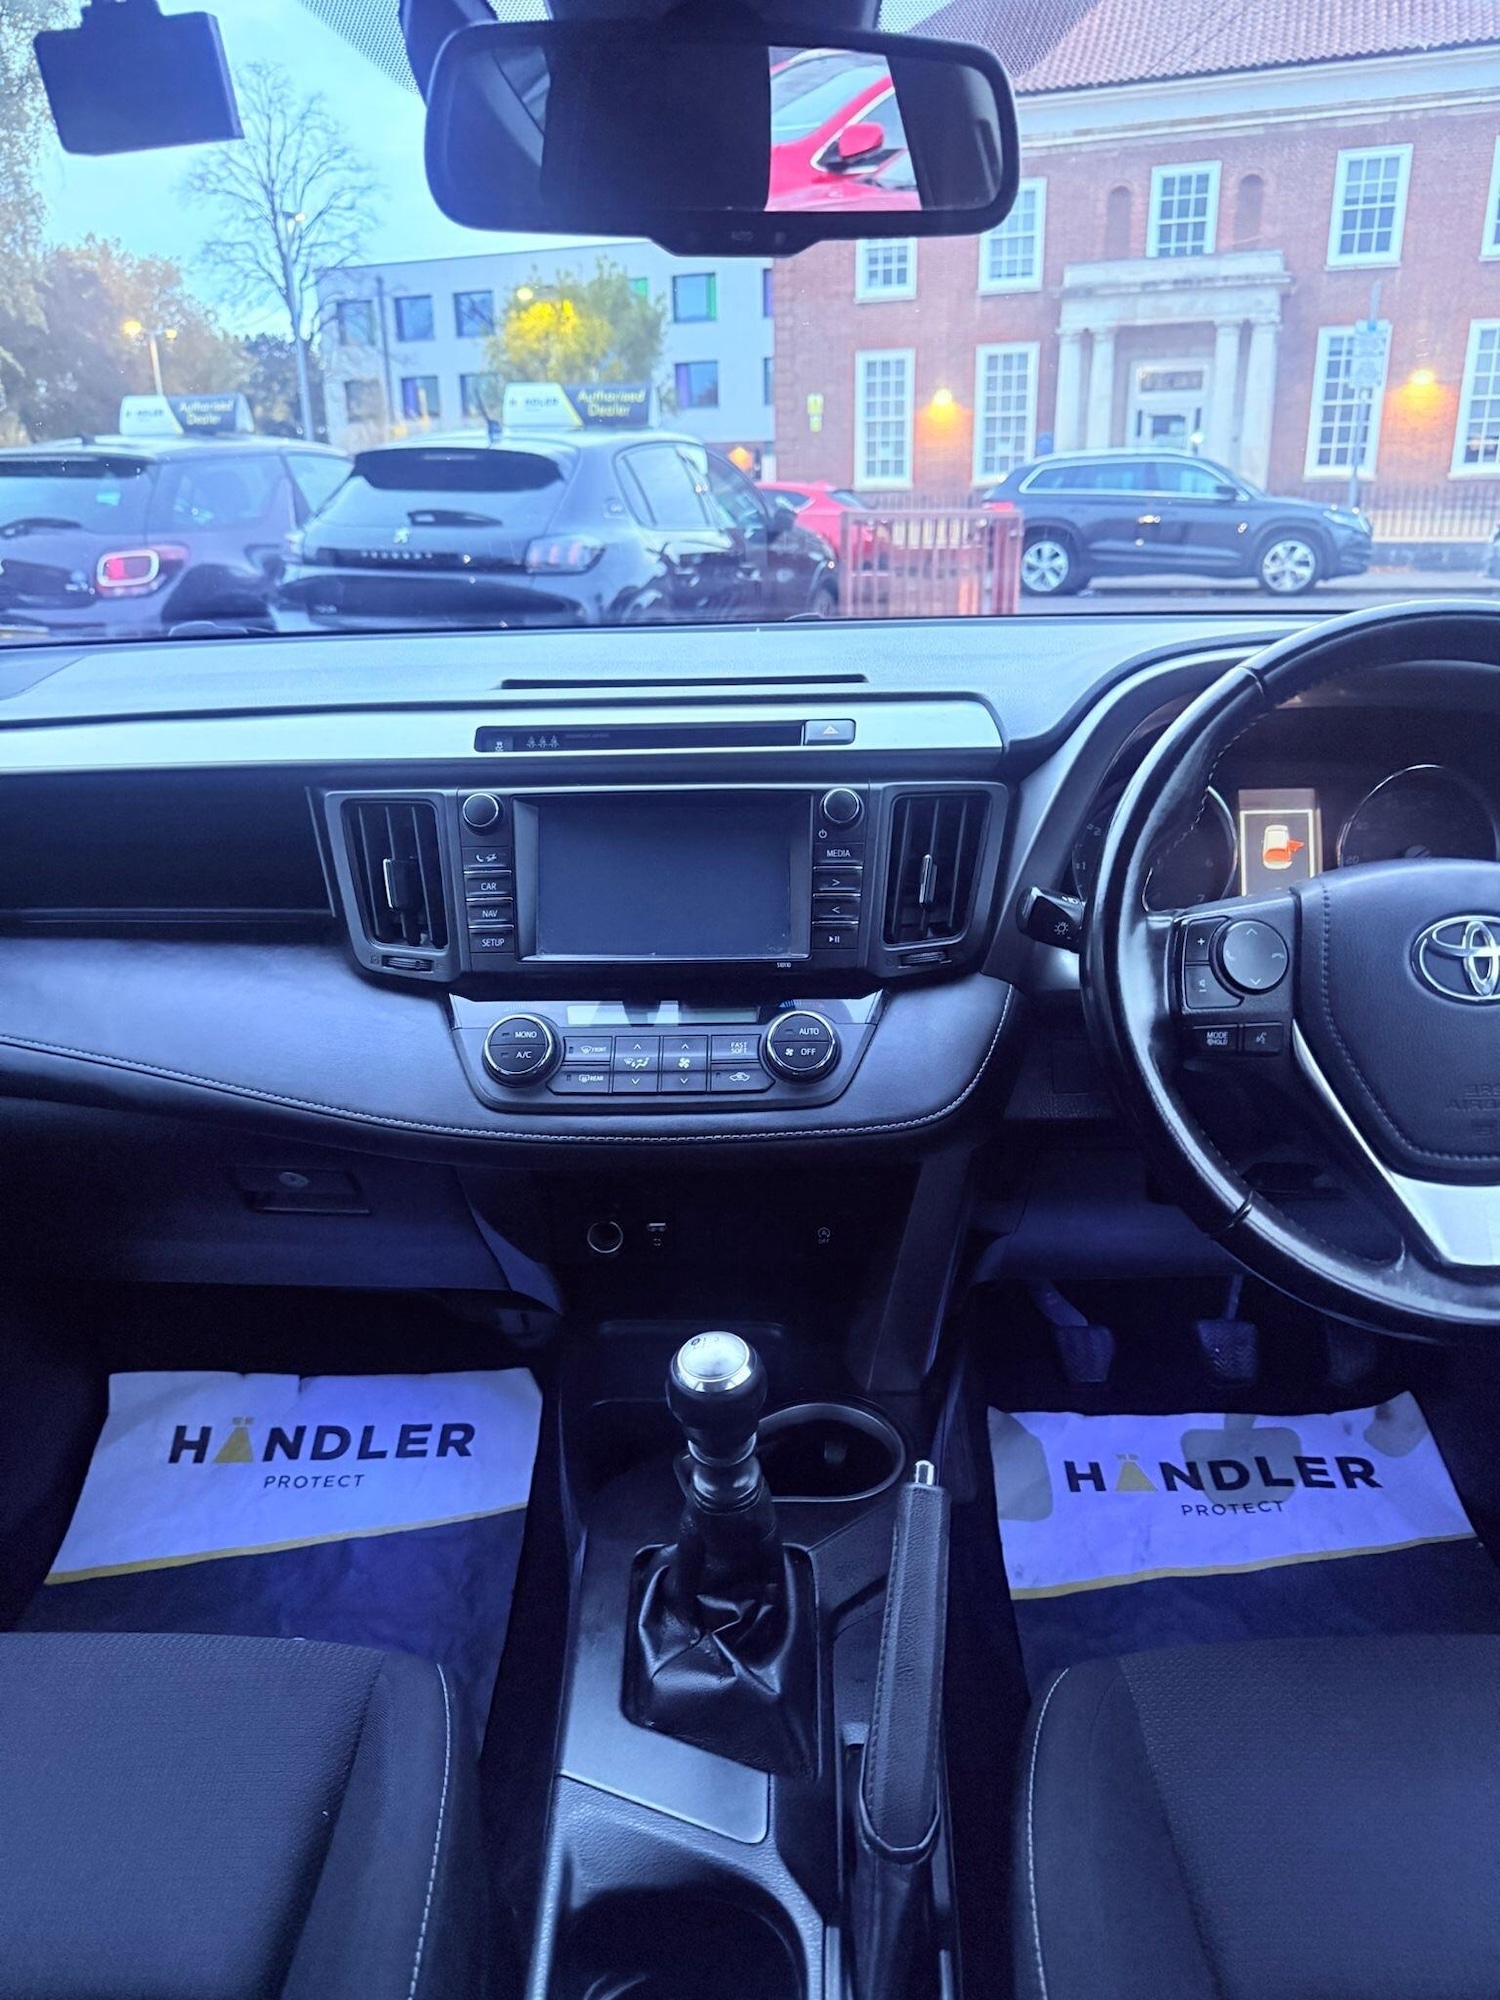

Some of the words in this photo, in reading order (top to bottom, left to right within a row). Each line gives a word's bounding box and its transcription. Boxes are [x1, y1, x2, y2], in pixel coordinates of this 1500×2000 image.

[826, 849, 851, 858] MEDIA
[480, 882, 497, 891] CAR
[482, 910, 498, 918] NAV
[482, 938, 505, 947] SETUP
[799, 1027, 820, 1035] AUTO
[1206, 1031, 1229, 1039] MODE
[516, 1051, 532, 1059] A/C
[801, 1048, 816, 1056] OFF
[263, 1474, 365, 1489] PROTECT
[1181, 1500, 1284, 1516] PROTECT
